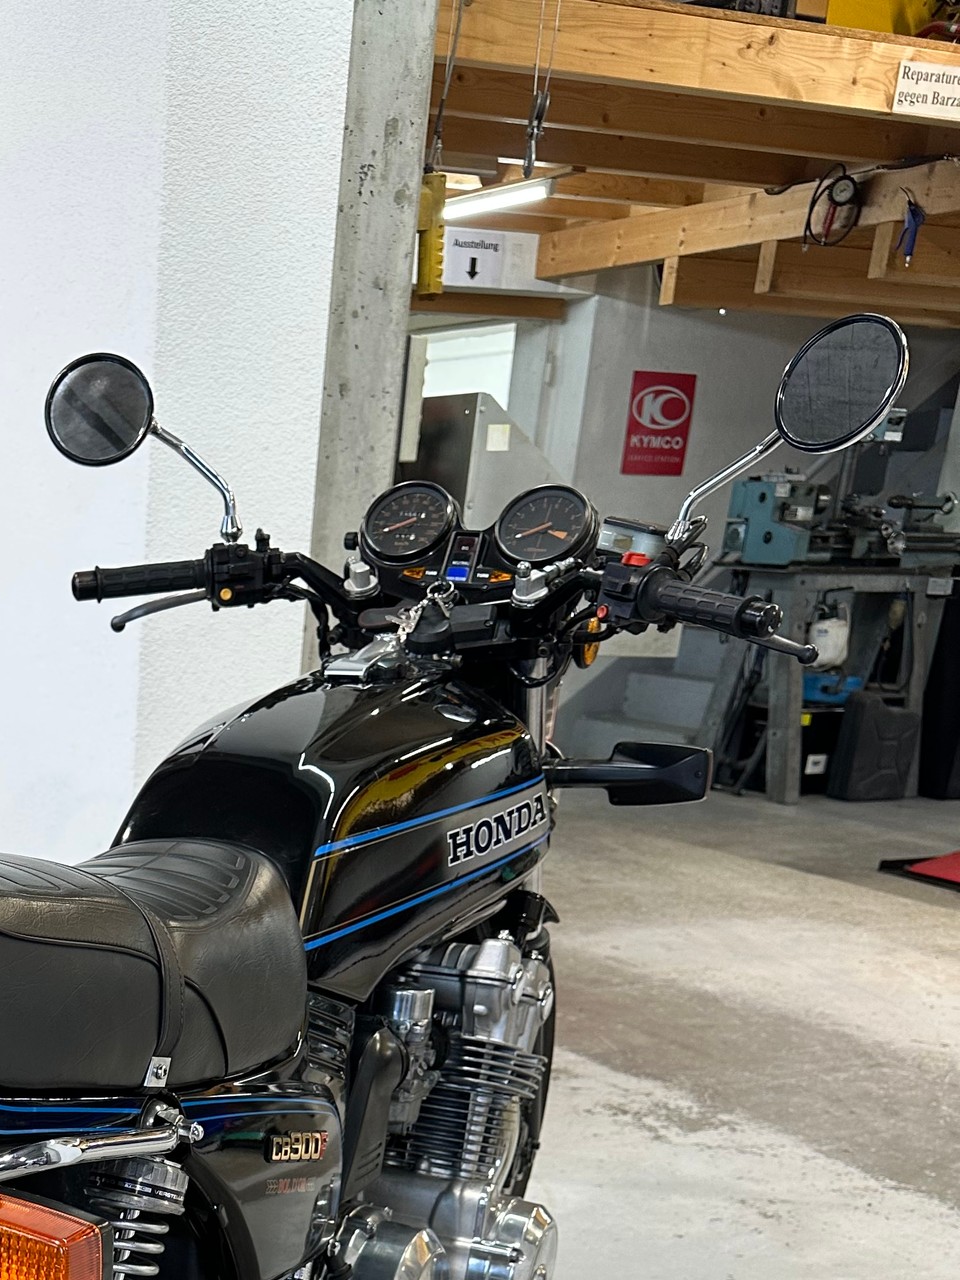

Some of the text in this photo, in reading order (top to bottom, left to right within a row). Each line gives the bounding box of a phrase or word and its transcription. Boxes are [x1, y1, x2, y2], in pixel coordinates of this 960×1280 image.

[897, 91, 960, 107] gegen Barza
[453, 238, 499, 252] Ausstellung
[630, 434, 683, 449] KYMCO
[447, 792, 548, 867] HONDA
[271, 1130, 329, 1161] CB900F
